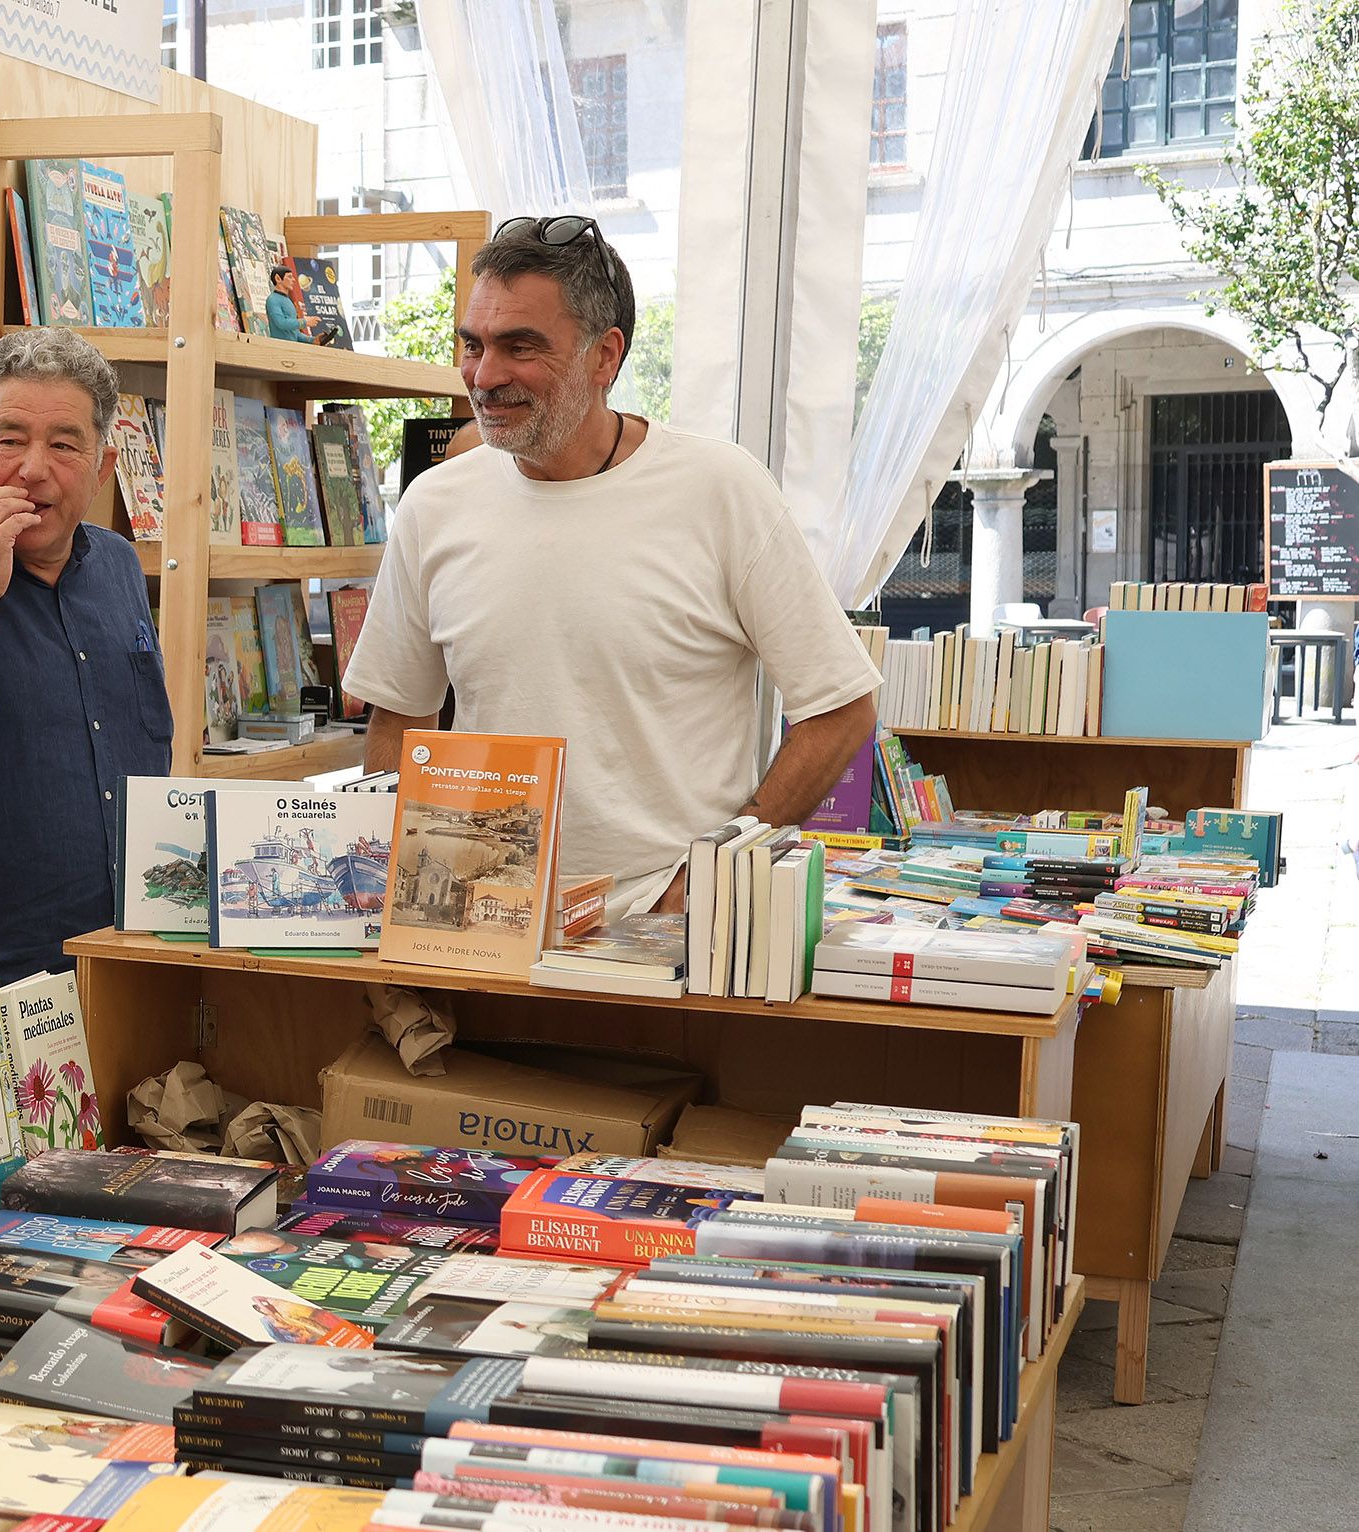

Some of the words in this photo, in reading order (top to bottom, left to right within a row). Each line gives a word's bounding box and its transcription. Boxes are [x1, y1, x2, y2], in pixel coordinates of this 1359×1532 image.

[317, 285, 326, 294] EL
[309, 295, 338, 305] SISTEMA
[315, 305, 337, 315] SOLAR
[421, 765, 501, 781] PONTEVEDRA
[507, 773, 539, 785] AYER
[432, 783, 458, 791] retratos
[468, 785, 491, 793] huellas
[506, 789, 526, 797] tiempo
[277, 799, 287, 810] O
[291, 798, 336, 811] Salnés
[185, 812, 199, 820] en
[291, 811, 337, 819] acuarelas
[310, 930, 340, 938] Baamonde
[413, 941, 431, 954] JOSÉ
[434, 946, 444, 955] M.
[446, 945, 470, 957] PIDRE
[472, 945, 502, 959] NOVÁS
[19, 996, 54, 1019] Plantas
[24, 1011, 75, 1041] medicinales
[459, 1110, 599, 1156] Arnoia
[317, 1186, 341, 1195] JOANA
[342, 1187, 371, 1198] MARCÚS
[425, 1192, 439, 1204] de
[531, 1219, 599, 1238] ELÍSABET
[625, 1229, 655, 1244] UNA
[659, 1231, 694, 1249] NIÑA
[527, 1234, 601, 1252] BENAVENT
[634, 1243, 682, 1258] BUENA
[29, 1343, 68, 1383] Bernardo
[60, 1327, 89, 1357] Atxaga
[52, 1352, 89, 1388] Golondrinas
[304, 1406, 334, 1418] JABOIS
[281, 1424, 310, 1435] JABOIS
[281, 1447, 310, 1458] JABOIS
